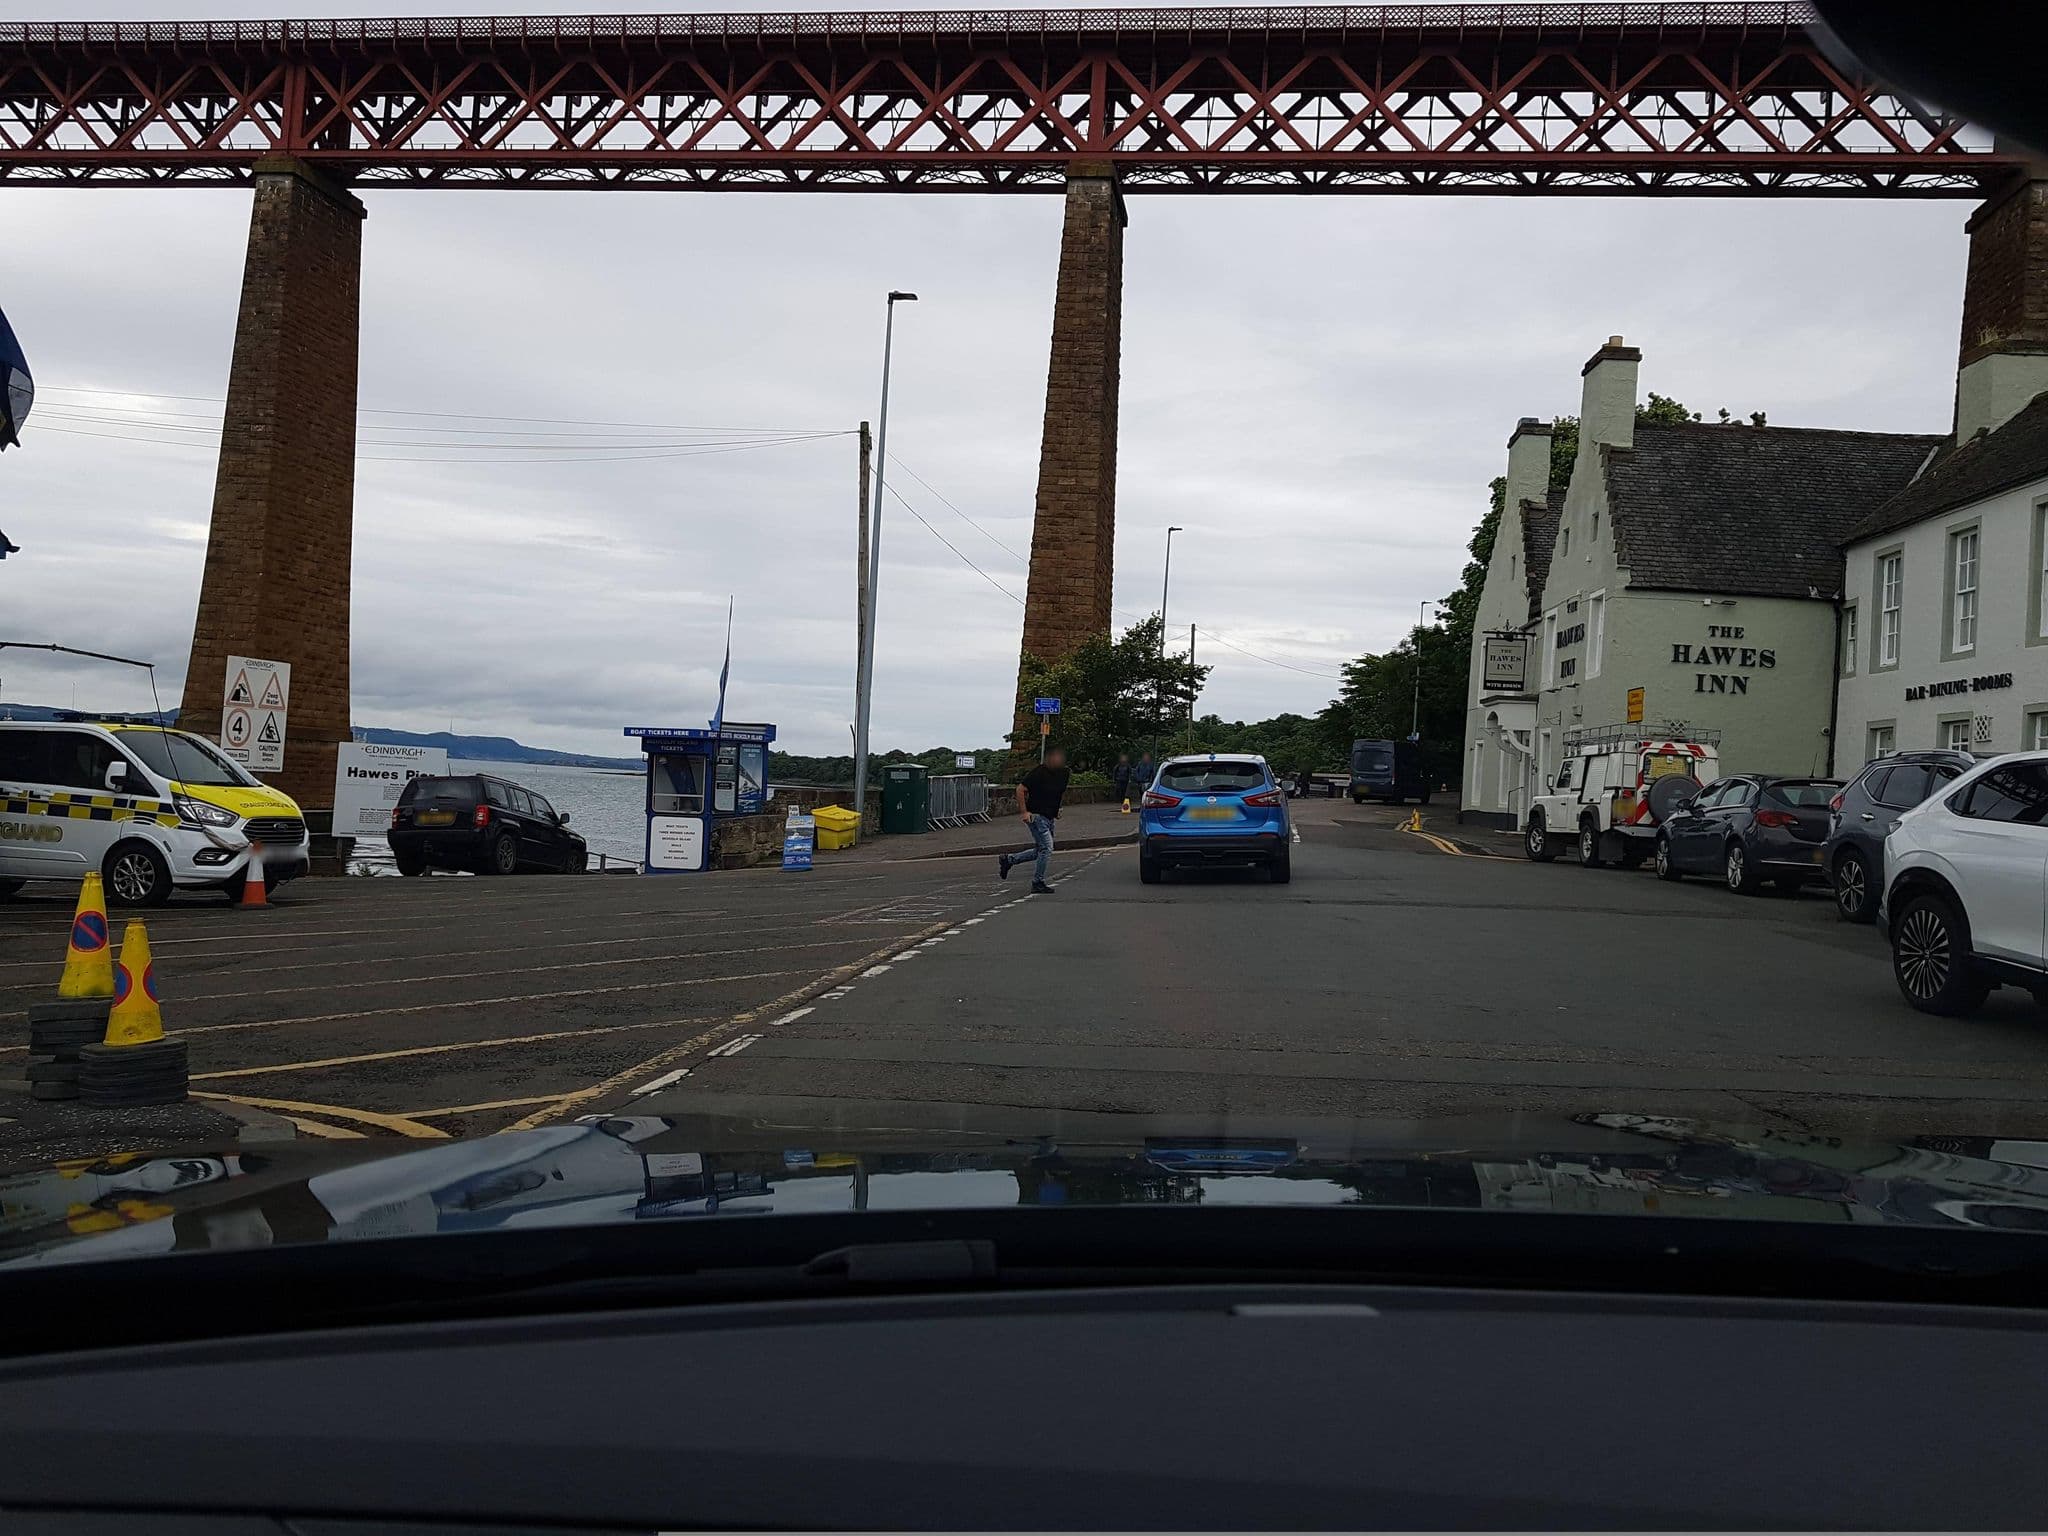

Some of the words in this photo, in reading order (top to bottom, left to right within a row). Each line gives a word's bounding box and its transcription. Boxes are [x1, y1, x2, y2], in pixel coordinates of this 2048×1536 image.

[1708, 624, 1745, 639] THE
[1671, 643, 1776, 669] HAWES
[1695, 674, 1750, 695] INN
[232, 716, 243, 735] 4
[347, 766, 399, 780] Hawes
